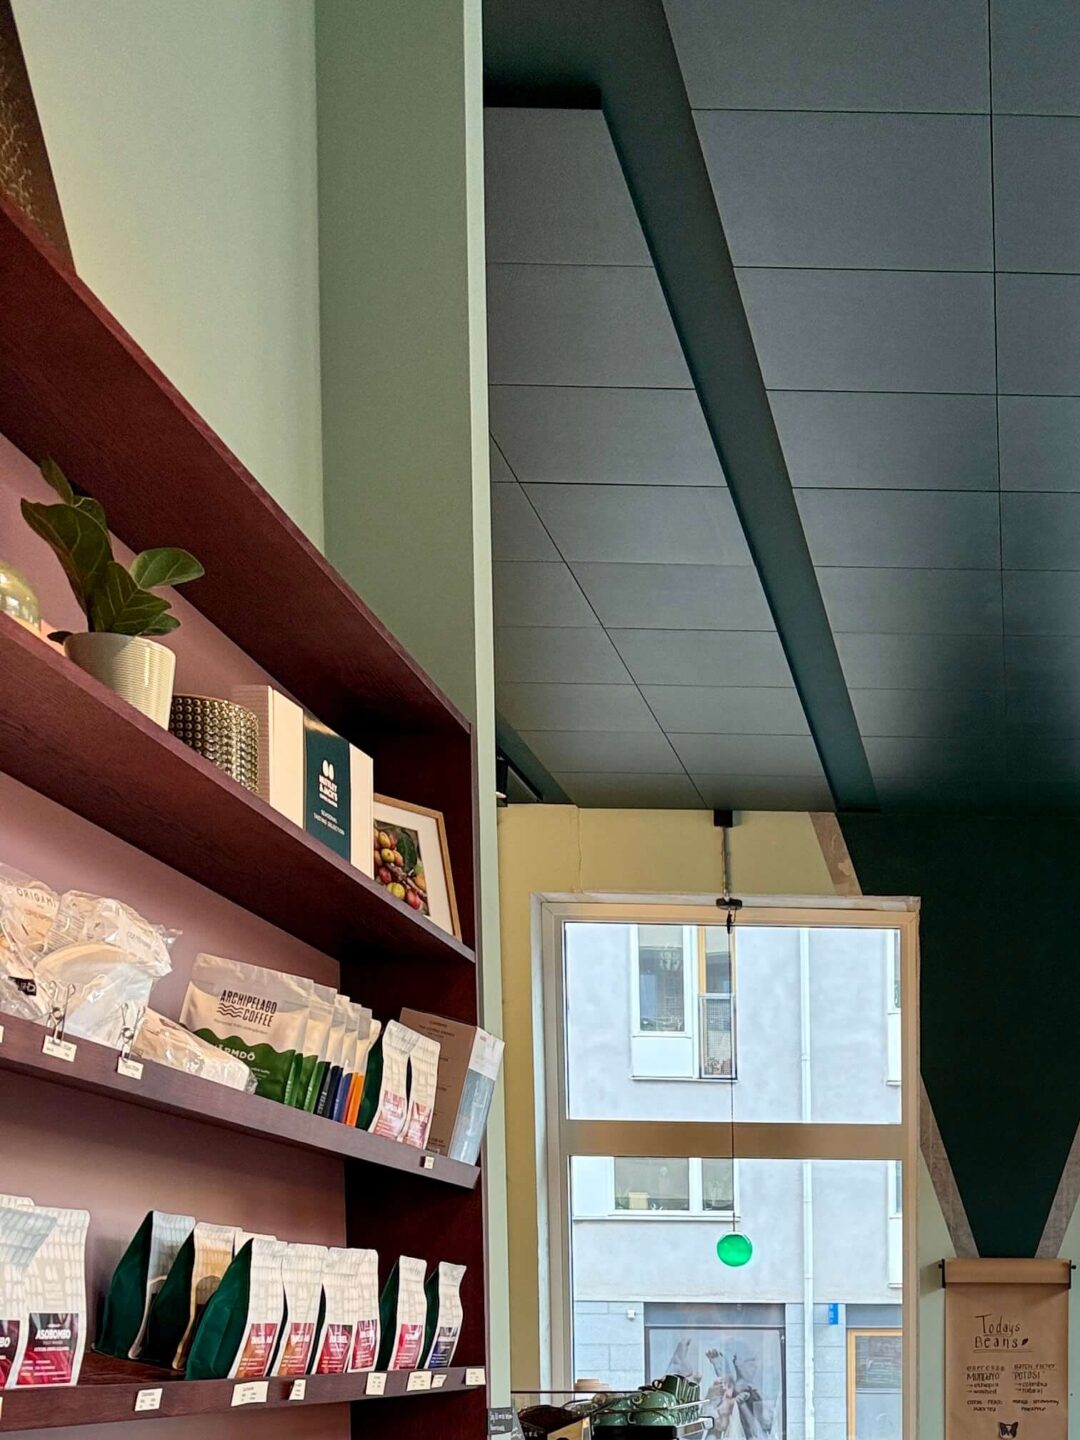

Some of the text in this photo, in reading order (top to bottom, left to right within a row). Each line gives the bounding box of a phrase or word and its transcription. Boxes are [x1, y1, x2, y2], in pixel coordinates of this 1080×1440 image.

[220, 990, 278, 1014] ARCHIPELAGO
[242, 1009, 274, 1027] COFFEE
[975, 1314, 1021, 1337] Todays
[975, 1336, 1018, 1349] Beans
